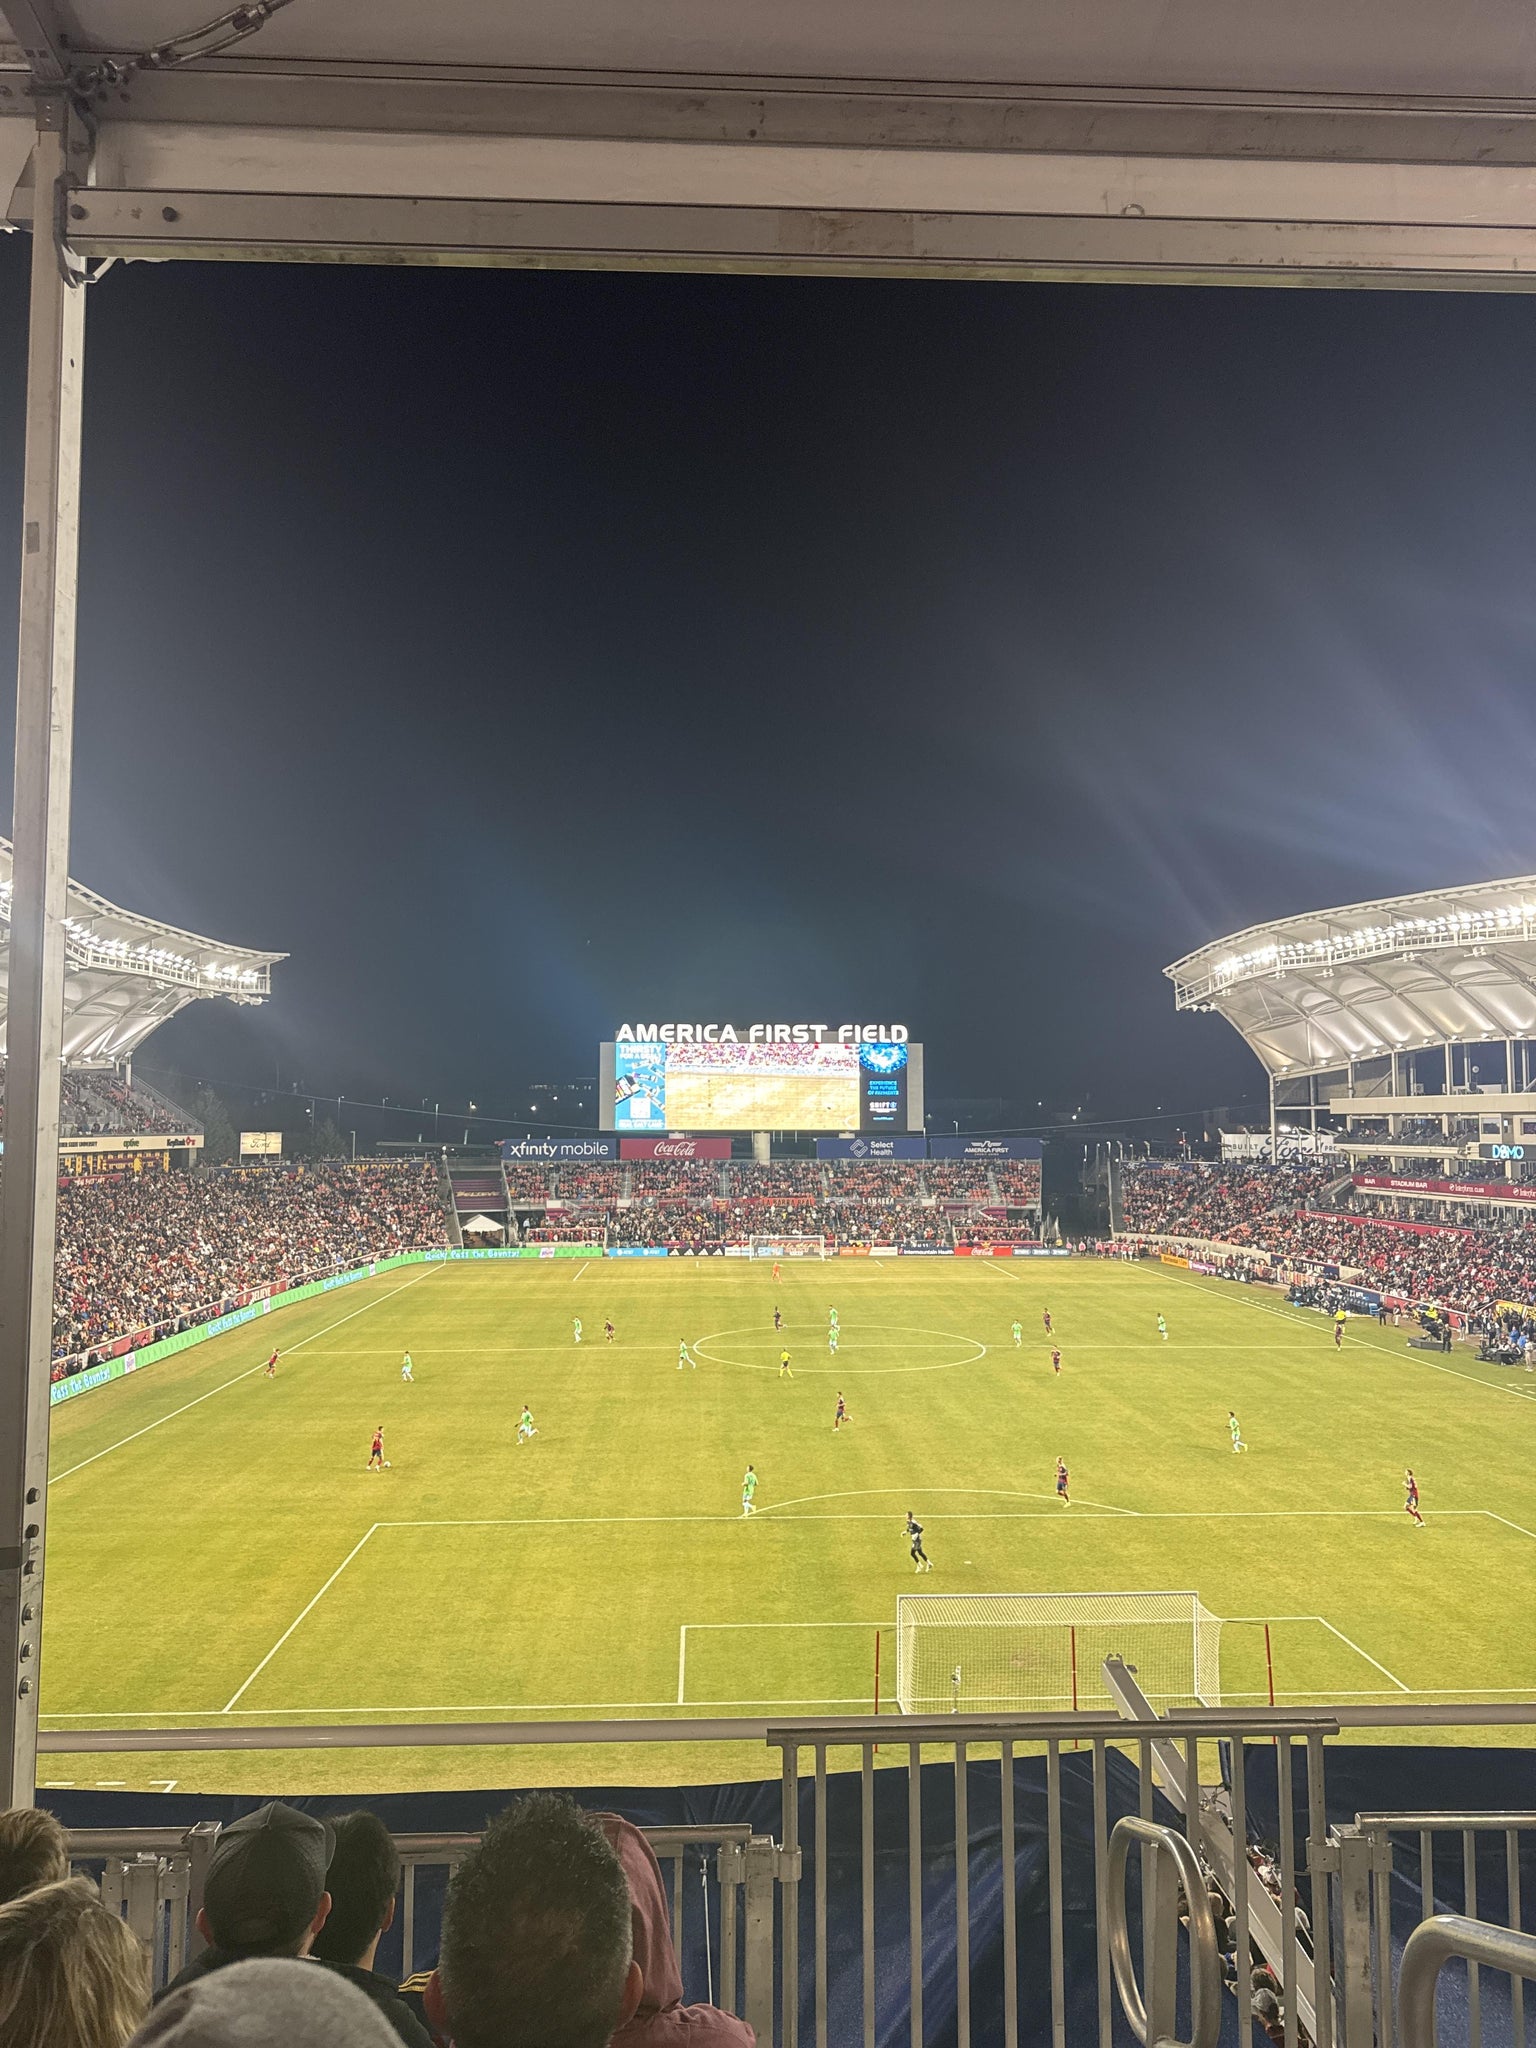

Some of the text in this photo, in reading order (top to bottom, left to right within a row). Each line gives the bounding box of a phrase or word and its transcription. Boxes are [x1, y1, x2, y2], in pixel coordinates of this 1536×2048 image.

[616, 1023, 908, 1044] AMERICA FIRST FIELD
[166, 1138, 186, 1148] KeyBank
[250, 1138, 271, 1149] Ford
[870, 1140, 894, 1149] Select
[510, 1142, 609, 1158] xfinity mobile
[653, 1141, 698, 1157] Coca-Cola
[870, 1148, 893, 1157] Health
[1491, 1144, 1525, 1160] DOMO
[343, 1163, 369, 1172] UTAH
[1390, 1180, 1414, 1189] STADIUM
[451, 1249, 469, 1260] Pass
[472, 1249, 485, 1259] the
[487, 1249, 520, 1259] Bounty!
[904, 1248, 938, 1256] Intermountain
[939, 1248, 955, 1256] Health
[252, 1286, 271, 1302] BELIEVE
[51, 1367, 111, 1402] Pass the Bounty!
